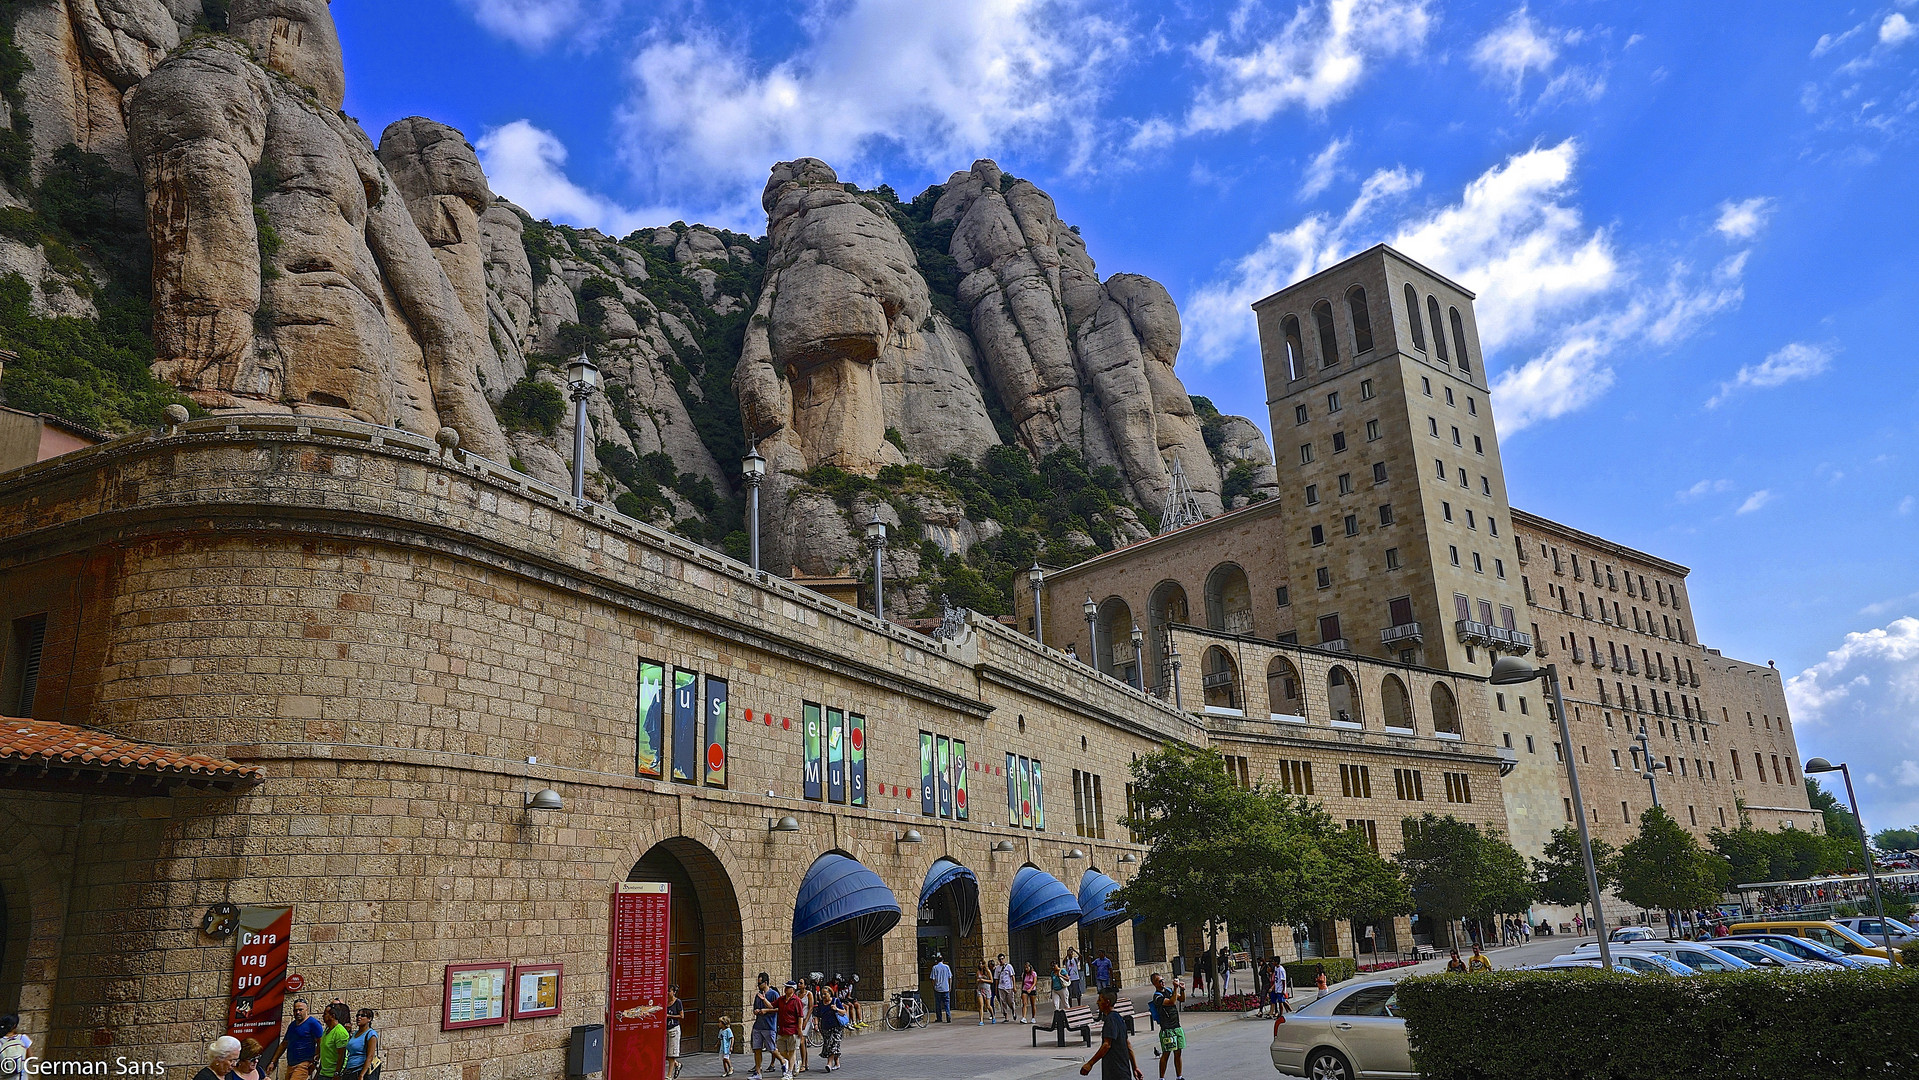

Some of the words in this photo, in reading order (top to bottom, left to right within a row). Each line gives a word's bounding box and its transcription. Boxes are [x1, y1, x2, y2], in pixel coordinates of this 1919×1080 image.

[243, 932, 277, 945] Cara
[241, 954, 267, 967] vag
[238, 974, 261, 989] gio
